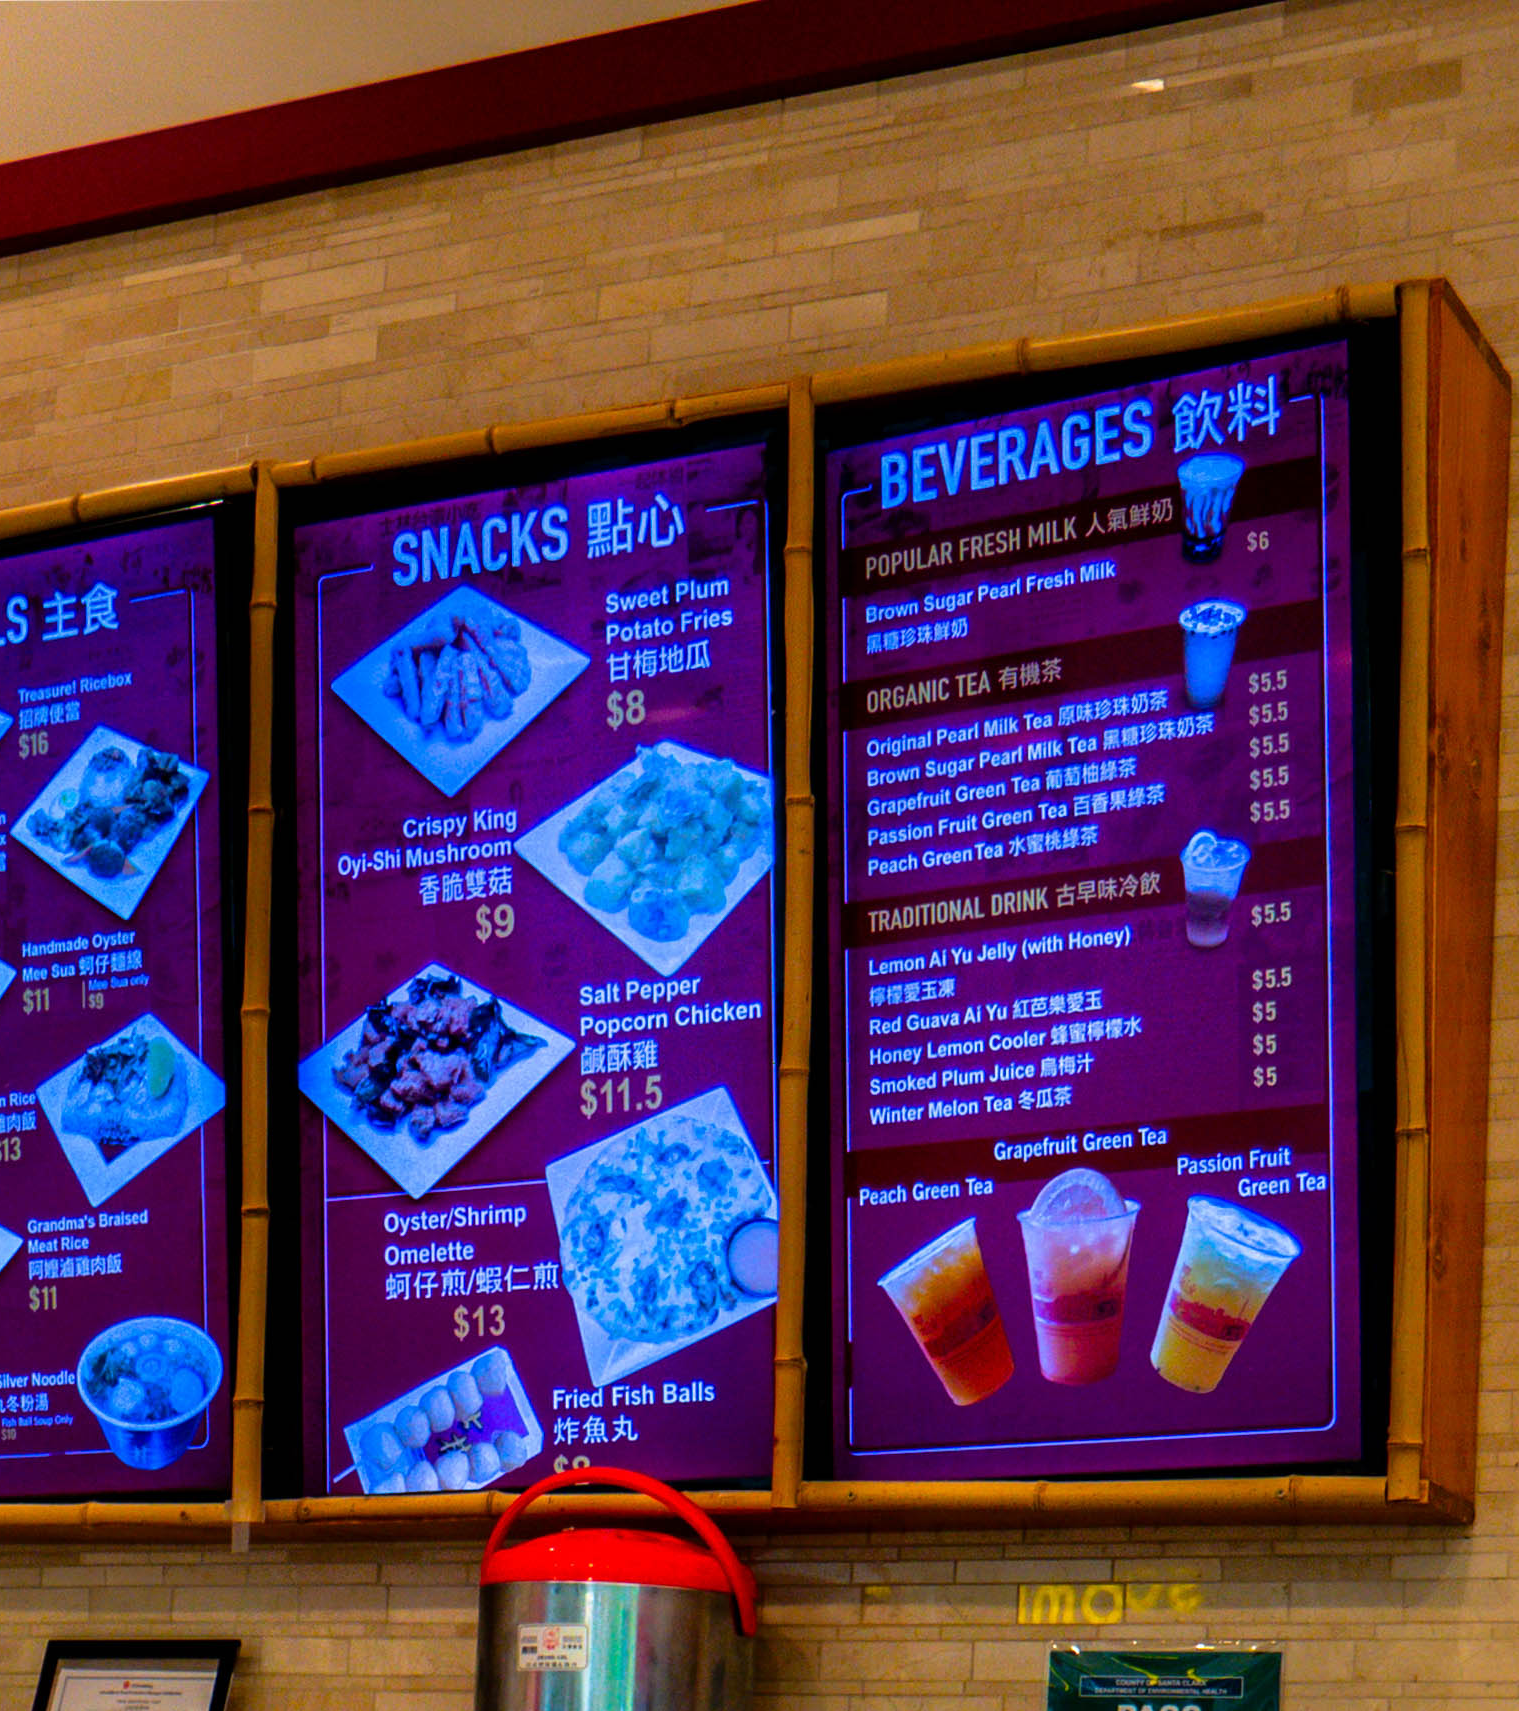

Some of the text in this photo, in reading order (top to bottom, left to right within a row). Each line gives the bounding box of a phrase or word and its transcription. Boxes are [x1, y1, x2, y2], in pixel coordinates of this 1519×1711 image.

[881, 374, 1280, 510] BEVERAGES 飲料
[392, 492, 684, 587] SNACKS 點心
[865, 497, 1173, 580] POPULAR FRESH MILK 人氣鮮奶
[865, 530, 1269, 623] Brown Sugar Pearl Fresh Milk $6
[42, 582, 119, 642] 主食
[605, 577, 729, 614] Sweet Plum
[606, 607, 733, 644] Potato Fries
[606, 639, 710, 684] 甘梅地瓜
[81, 672, 132, 692] Ricebox
[866, 658, 1062, 713] ORGANIC TEA 有機茶
[606, 689, 646, 731] $8
[866, 731, 932, 758] Original
[936, 725, 979, 745] Pearl
[984, 718, 1019, 738] Milk
[1024, 712, 1053, 732] Tea
[1248, 669, 1287, 695] $5.5
[19, 730, 49, 760] $16
[867, 789, 952, 818] Grapefruit
[955, 783, 1006, 802] Green
[1011, 776, 1041, 794] Tea
[1249, 733, 1290, 759] $5.5
[402, 808, 517, 840] Crispy King
[337, 838, 513, 878] Oyi-Shi Mushroom
[419, 866, 513, 906] 香脆雙菇
[868, 871, 1161, 934] TRADITIONAL DRINK 古早味冷飲
[475, 903, 515, 943] $9
[868, 901, 1292, 977] Lemon Ai Yu Jelly (with Honey) $5.5
[22, 931, 135, 957] Handmade Oyster
[22, 963, 75, 982] Mee Sua
[580, 976, 700, 1006] Salt Pepper
[23, 988, 50, 1015] $11
[89, 994, 104, 1009] $9
[580, 1001, 762, 1037] Popcorn Chicken
[869, 1015, 902, 1036] Red
[906, 1010, 959, 1032] Guava
[964, 1006, 982, 1023] Ai
[986, 1004, 1008, 1022] Yu
[1252, 966, 1293, 991] $5.5
[9, 1093, 36, 1107] Rice
[580, 1075, 663, 1119] $11.5
[870, 1066, 1277, 1127] Winter Melon Tea 冬瓜茶 $5
[28, 1209, 148, 1234] Grandma's Braised
[383, 1204, 528, 1234] Oyster/Shrimp
[28, 1236, 89, 1254] Meat Rice
[384, 1243, 474, 1266] Omelette
[29, 1285, 58, 1312] $11
[385, 1262, 560, 1302] 蚵仔煎/蝦仁煎
[453, 1304, 505, 1341] $13
[31, 1371, 75, 1386] Noodle
[552, 1381, 715, 1409] Fried Fish Balls
[552, 1416, 638, 1446] 炸魚丸
